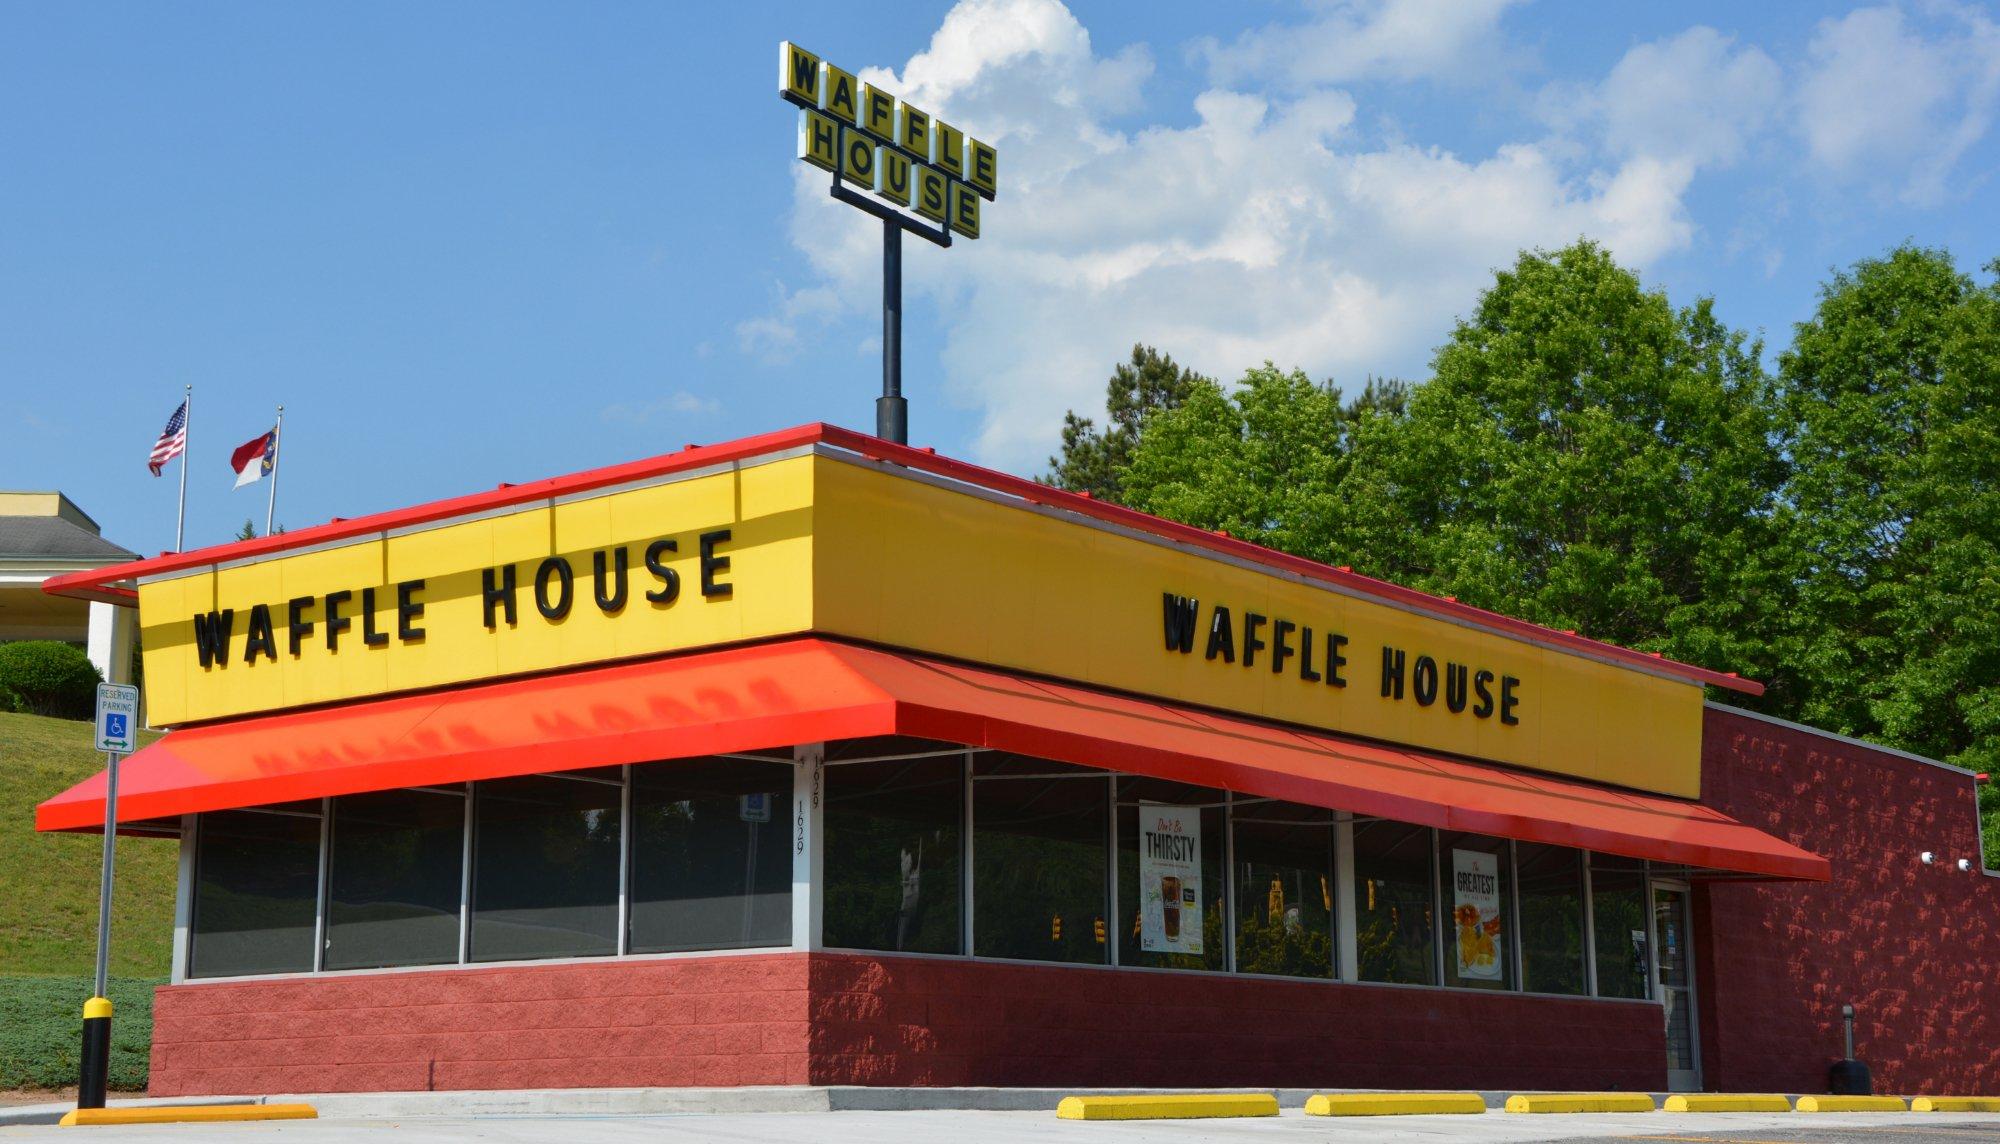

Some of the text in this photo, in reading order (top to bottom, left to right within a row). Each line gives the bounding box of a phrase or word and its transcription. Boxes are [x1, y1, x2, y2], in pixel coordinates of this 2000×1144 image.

[793, 50, 993, 185] WAFFLE
[814, 118, 976, 228] HOUSE
[194, 529, 734, 669] WAFFLE HOUSE
[1163, 592, 1521, 726] WAFFLE HOUSE
[100, 689, 135, 701] RESERVED
[102, 701, 132, 713] PARKING
[1145, 831, 1195, 862] THIRSTY
[1457, 871, 1495, 895] GREATEST
